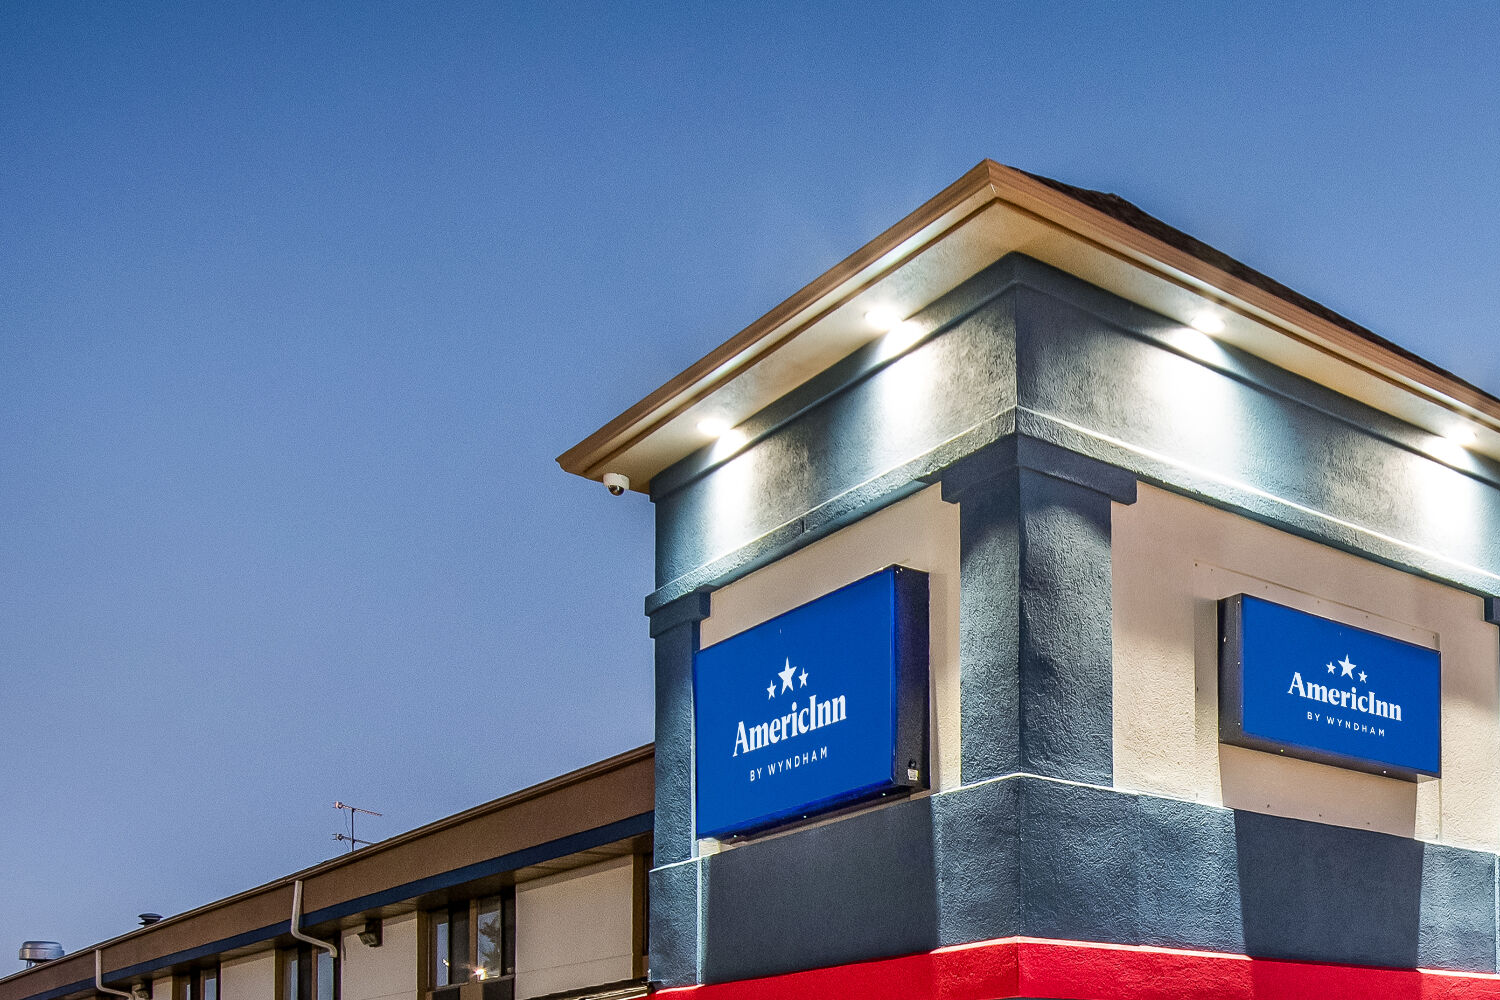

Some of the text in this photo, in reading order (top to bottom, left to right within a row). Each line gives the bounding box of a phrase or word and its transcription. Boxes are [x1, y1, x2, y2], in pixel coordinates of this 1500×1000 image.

[1287, 671, 1402, 722] AmericInn
[732, 694, 847, 757] AmericInn
[1307, 711, 1385, 737] BY WYNDHAM
[750, 746, 828, 782] BY WYNDHAM
